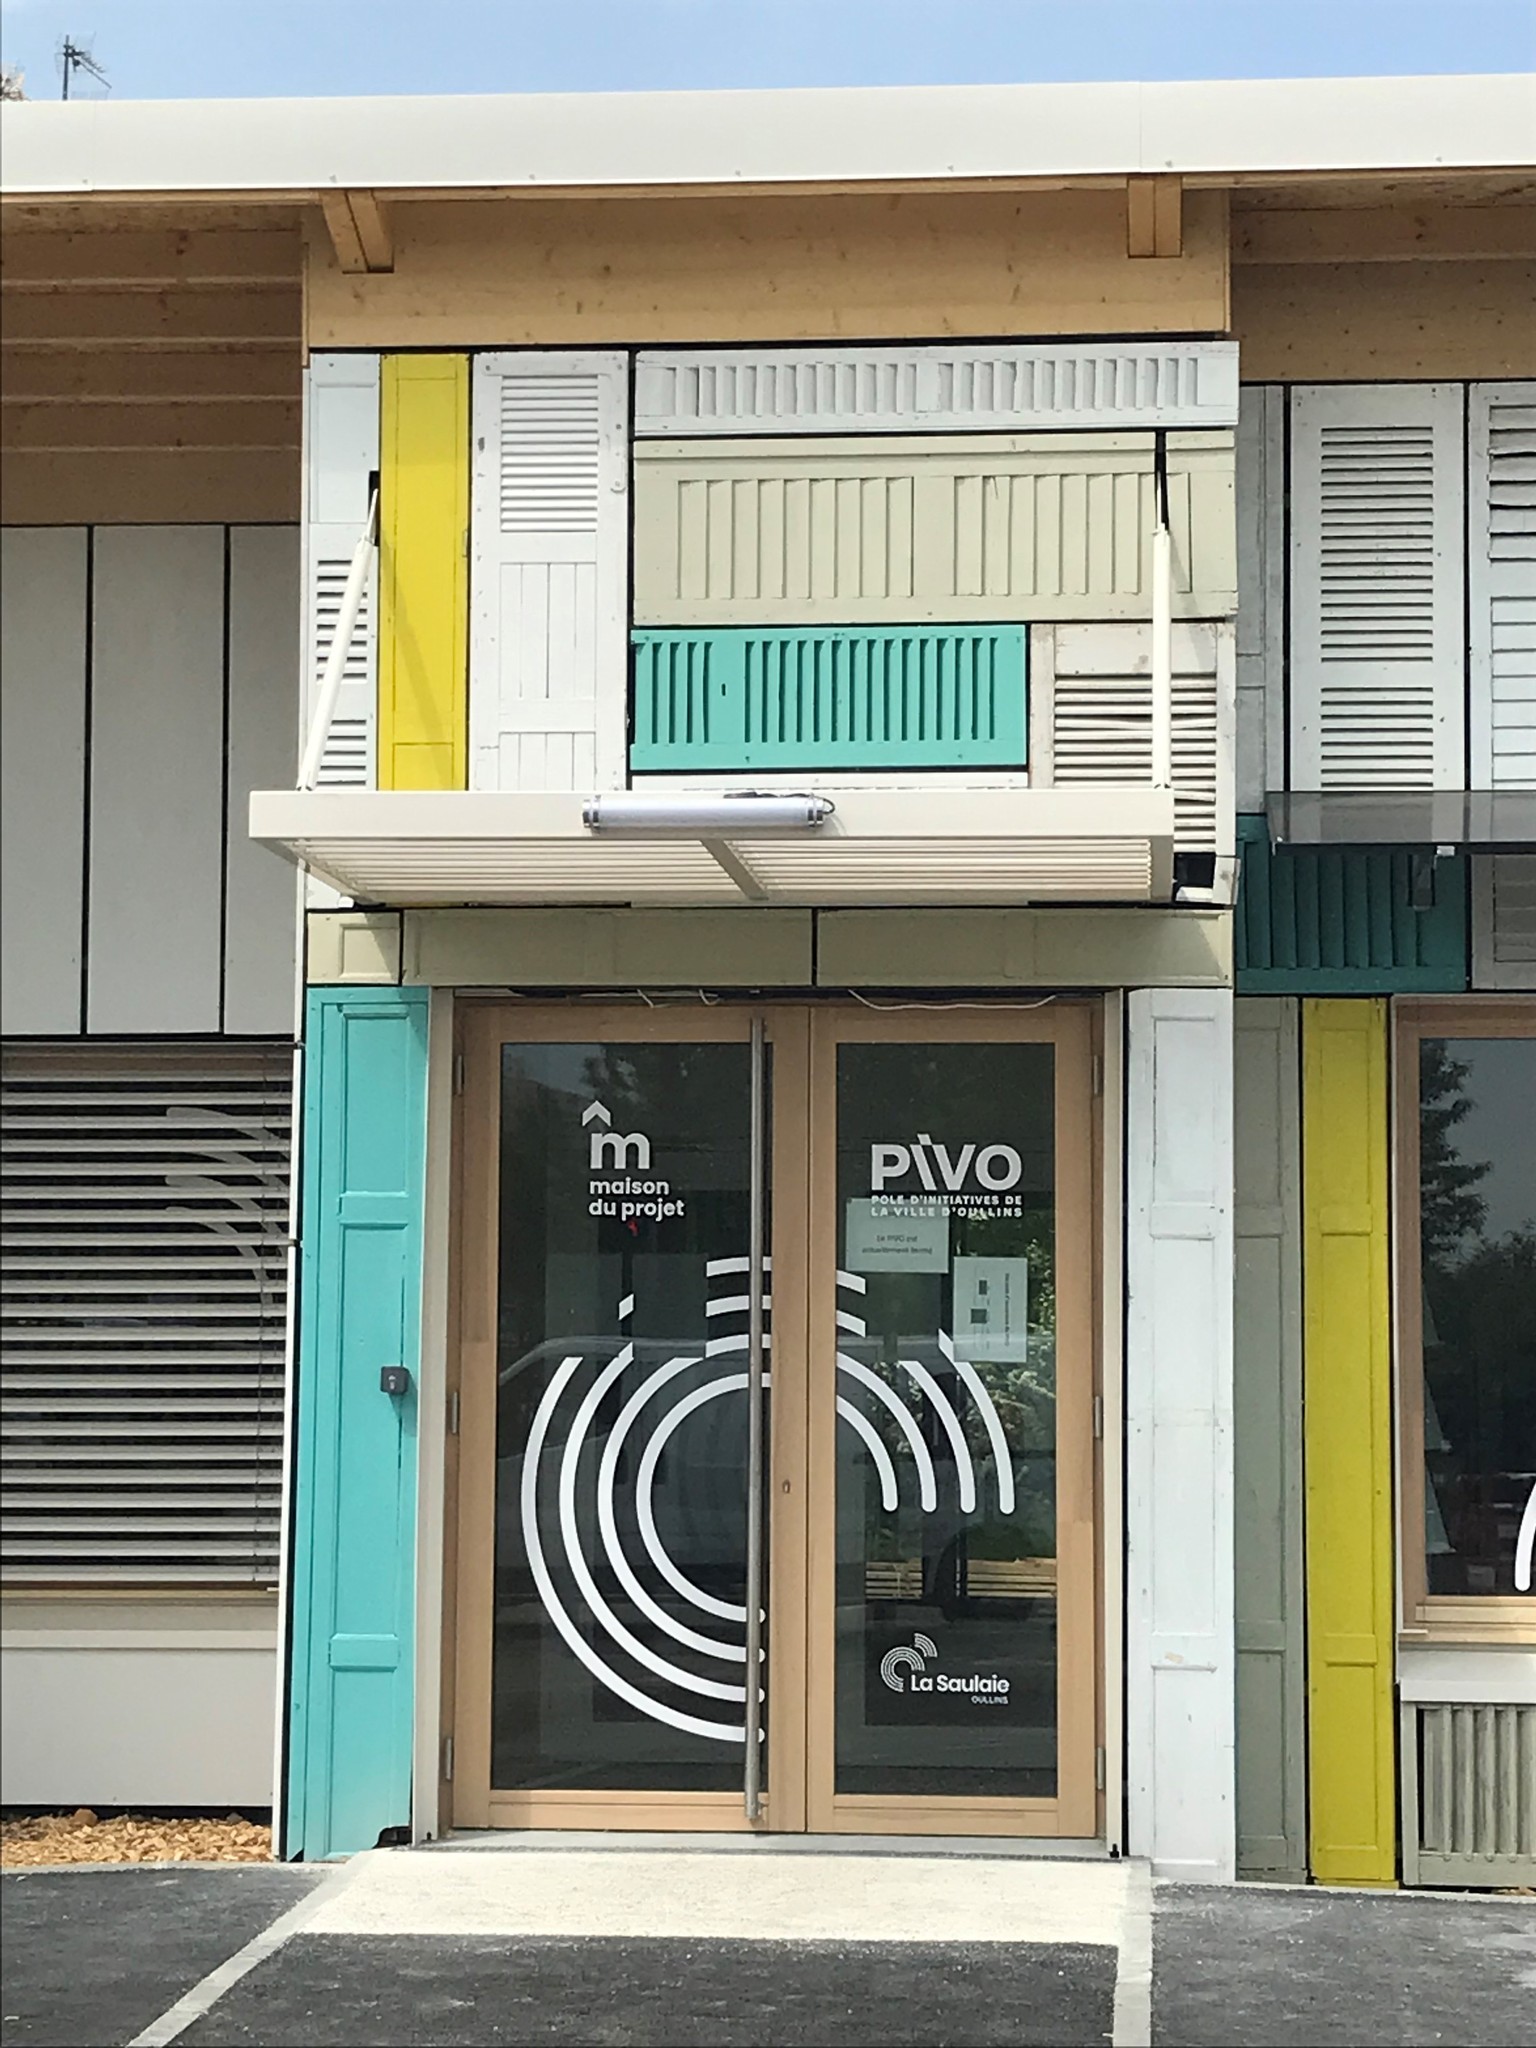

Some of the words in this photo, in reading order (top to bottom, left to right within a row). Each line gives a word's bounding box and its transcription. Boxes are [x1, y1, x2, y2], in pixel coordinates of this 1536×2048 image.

[589, 1176, 669, 1195] maison
[910, 1195, 999, 1205] D'INITIATIVES
[1005, 1195, 1022, 1205] DE
[588, 1198, 616, 1216] du
[621, 1197, 685, 1222] projet
[871, 1207, 889, 1217] LA
[893, 1207, 936, 1217] VILLE
[911, 1674, 933, 1691] La
[936, 1674, 1010, 1693] Saulaie
[971, 1695, 1008, 1704] OULLINS
